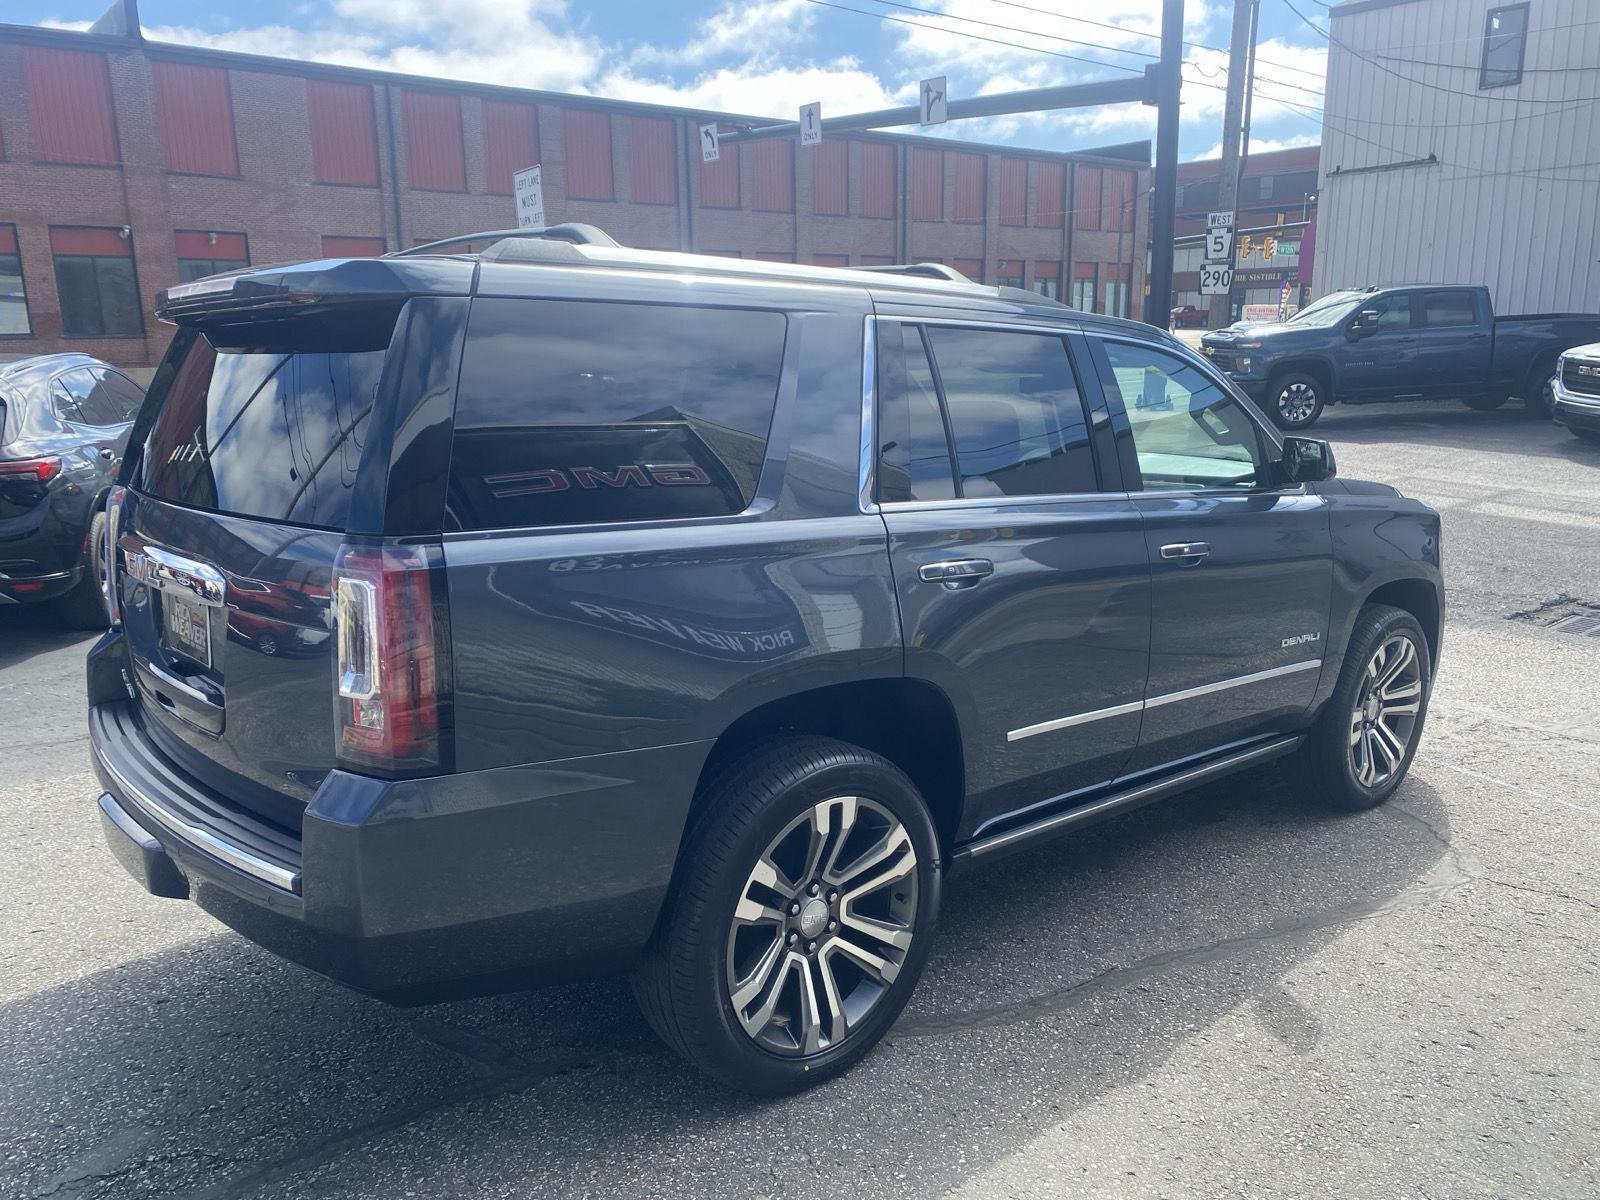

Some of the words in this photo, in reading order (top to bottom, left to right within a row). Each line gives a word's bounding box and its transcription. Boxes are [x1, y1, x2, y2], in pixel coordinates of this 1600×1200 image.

[803, 132, 818, 141] ONLY
[704, 151, 717, 159] ONLY
[517, 178, 527, 191] LEFT
[528, 174, 540, 187] LANE
[521, 194, 537, 208] MUST
[519, 215, 531, 226] TURN
[532, 212, 543, 224] LEFT
[1210, 214, 1232, 226] WEST
[1213, 236, 1224, 252] 5
[1202, 270, 1230, 287] 290
[124, 550, 165, 588] GMC
[1281, 632, 1320, 647] DENALI
